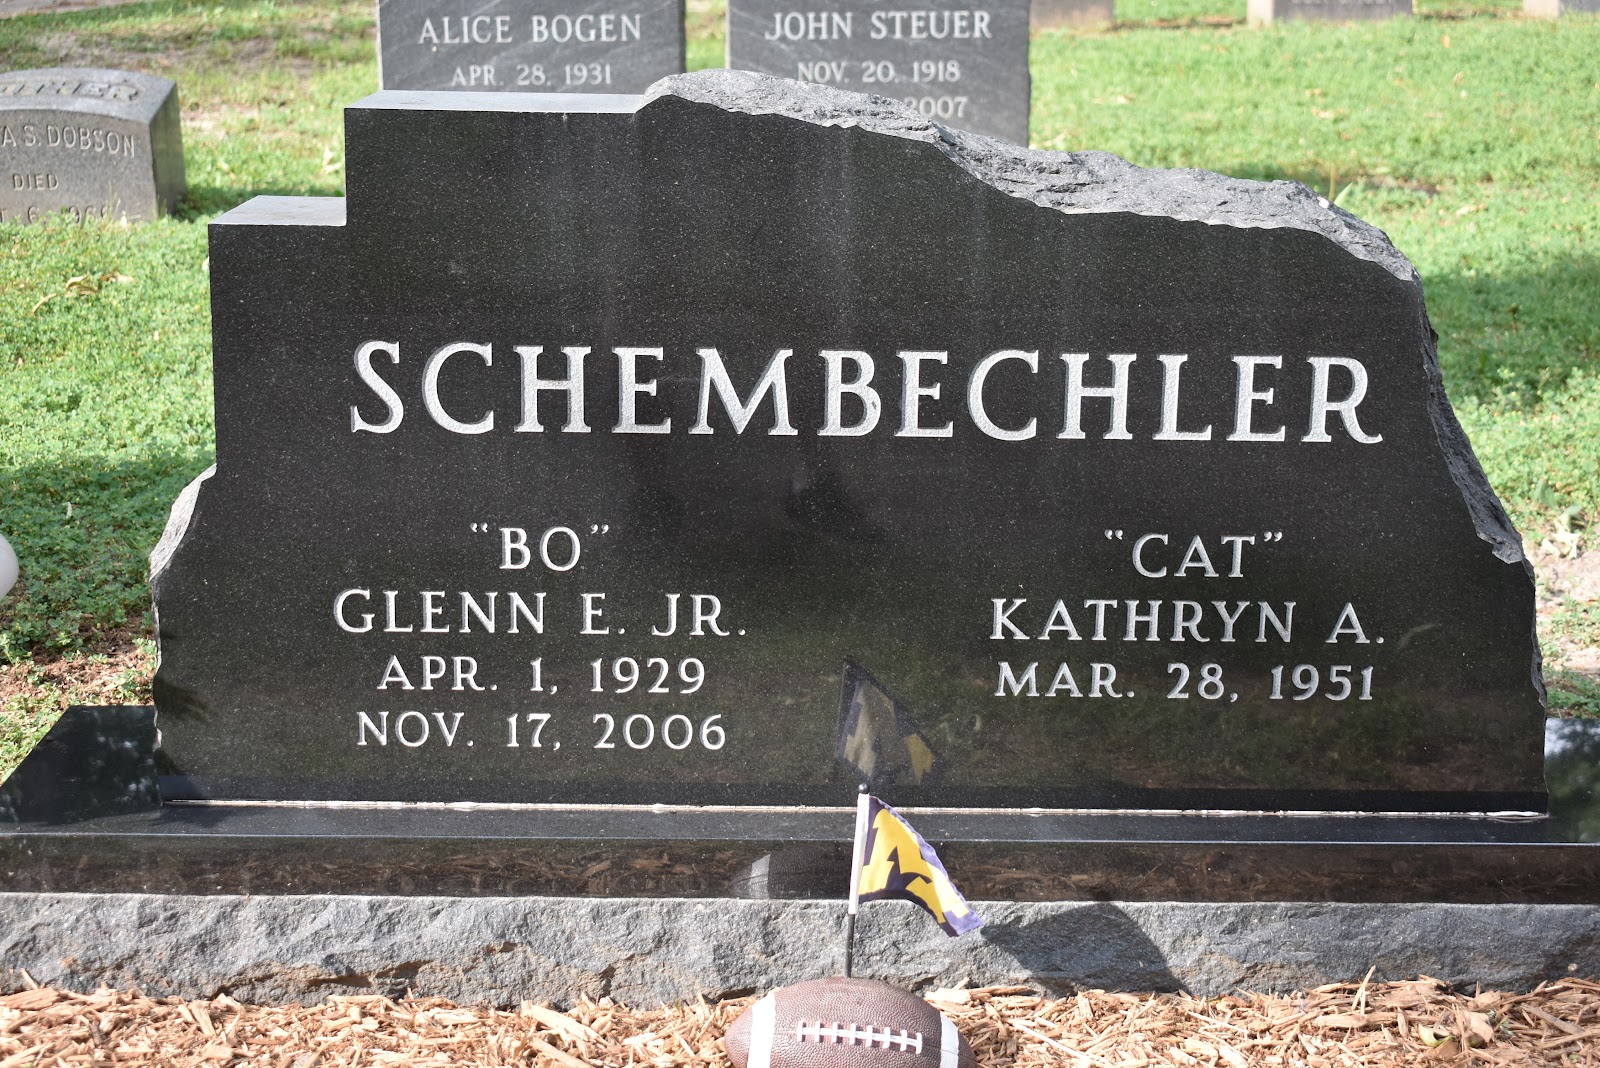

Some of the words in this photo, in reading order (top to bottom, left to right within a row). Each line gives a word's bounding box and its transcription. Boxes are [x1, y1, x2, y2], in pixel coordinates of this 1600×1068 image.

[418, 15, 513, 44] ALICE
[531, 14, 642, 43] BOGEN
[764, 11, 853, 40] JOHN
[870, 10, 993, 39] STEUER
[450, 64, 504, 87] APR.
[565, 63, 612, 85] 1931
[912, 60, 961, 83] 1918
[23, 124, 42, 147] S.
[47, 124, 136, 159] DOBSON
[12, 173, 61, 191] DIED
[350, 339, 1384, 444] SCHEMBECHLER
[333, 588, 548, 634] GLENN
[579, 592, 625, 635] E.
[651, 593, 747, 637] JR.
[989, 597, 1297, 643] KATHRYN
[1325, 602, 1386, 644] A.
[376, 655, 499, 691] APR.
[529, 657, 559, 695] 1,
[590, 657, 706, 695] 1929
[993, 661, 1136, 698] MAR.
[1165, 662, 1240, 702] 28,
[1269, 664, 1375, 701] 1951
[356, 711, 475, 748] NOV.
[506, 713, 562, 751] 17,
[591, 713, 727, 750] 2006
